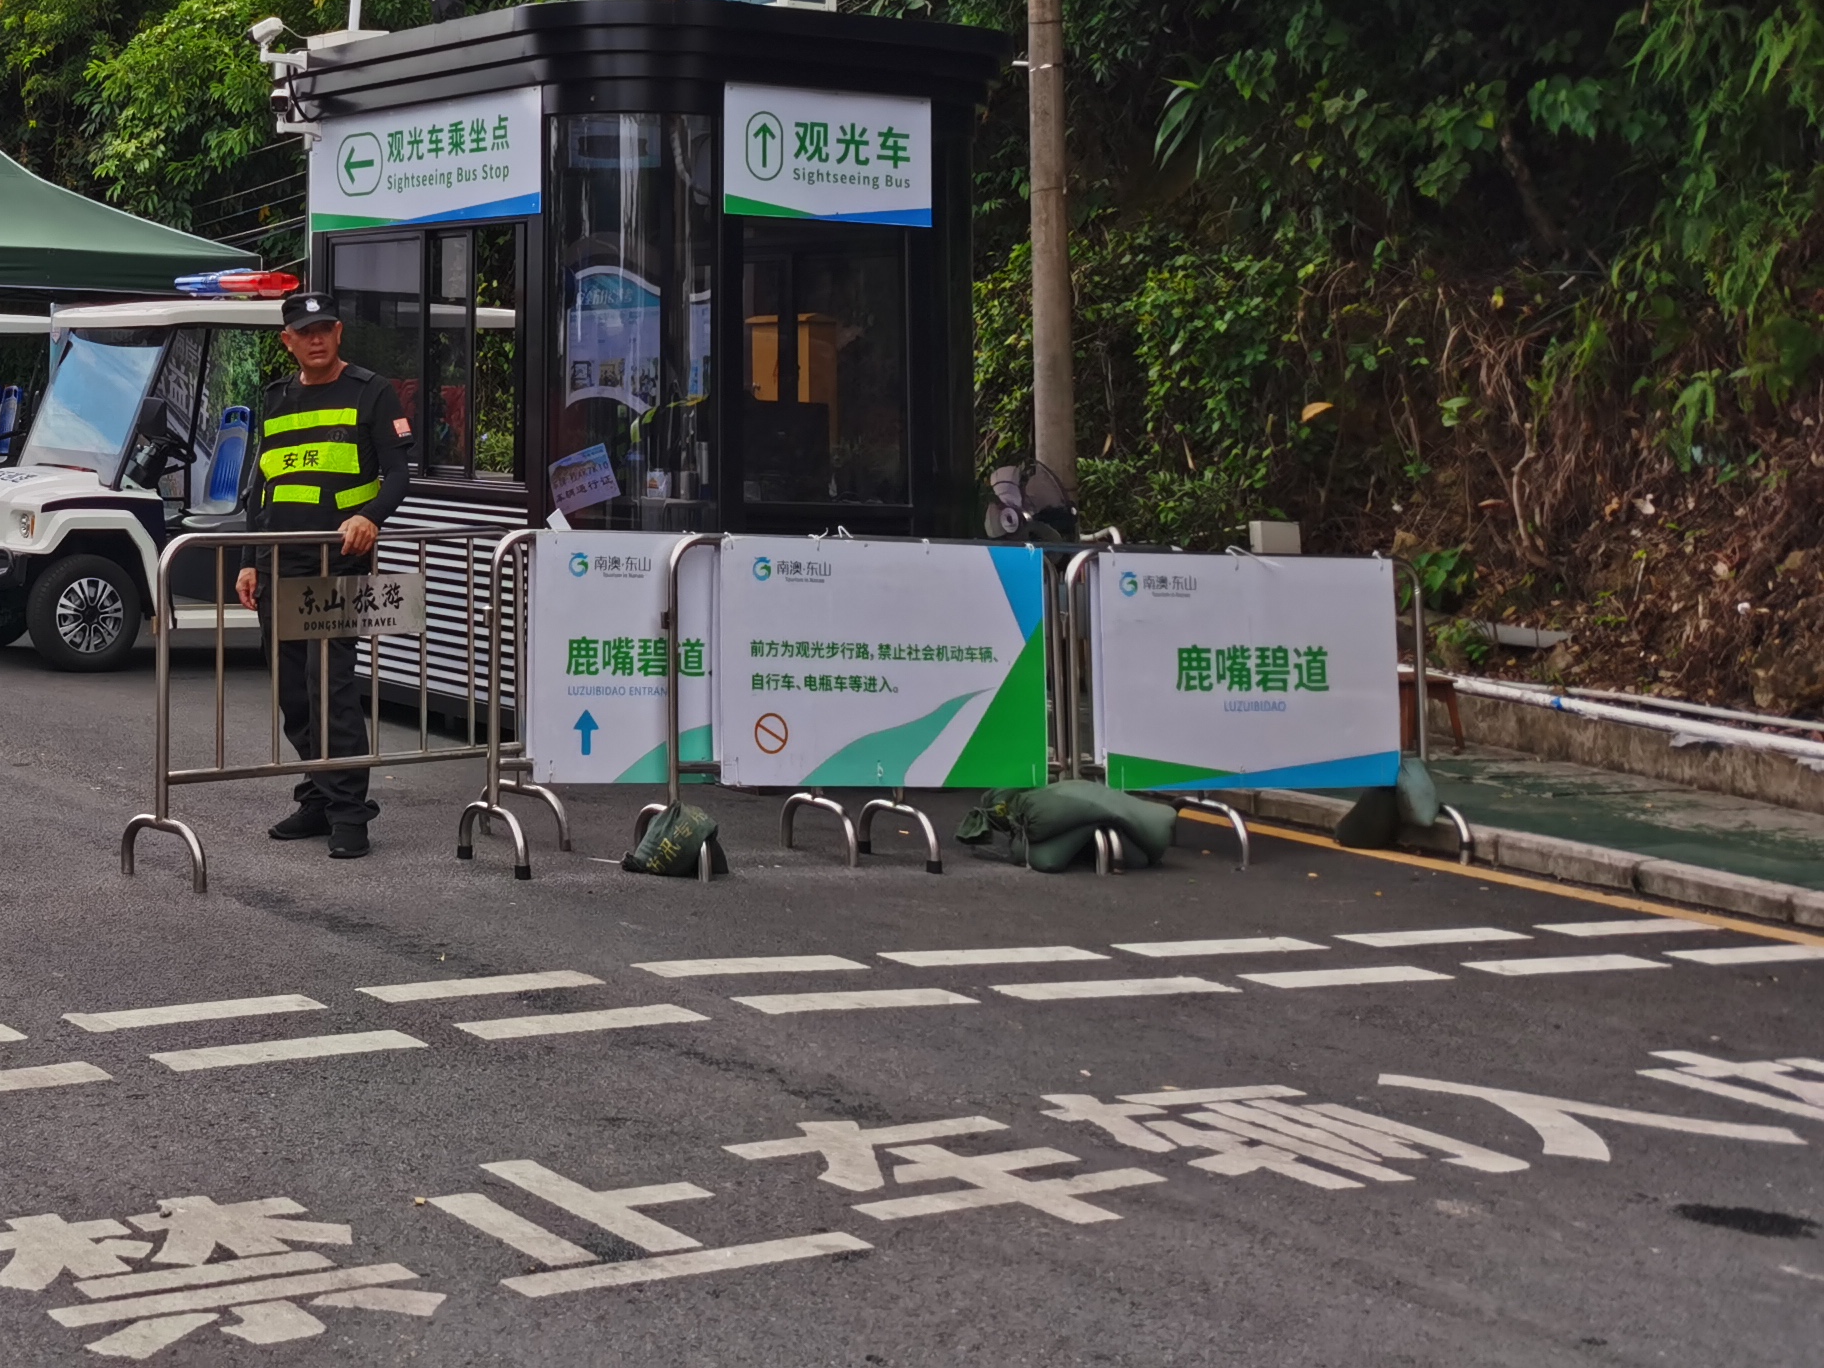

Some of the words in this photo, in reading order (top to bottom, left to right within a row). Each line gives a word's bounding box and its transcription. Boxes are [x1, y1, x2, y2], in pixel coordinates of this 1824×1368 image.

[387, 114, 509, 163] 观光车乘坐点
[793, 121, 911, 169] 观光车
[387, 169, 453, 193] Sightseeing
[457, 167, 477, 183] Bus
[482, 164, 509, 182] Stop
[793, 167, 880, 190] Sightseeing
[885, 175, 911, 189] Bus
[283, 450, 319, 470] 安保
[299, 582, 404, 616] 东山旅游
[304, 618, 358, 631] DONGSHAN
[362, 617, 397, 627] TRAVEL
[566, 636, 705, 677] 鹿嘴碧道
[1176, 644, 1330, 693] 鹿嘴碧道
[568, 686, 626, 696] LUZUIBIDAO
[751, 673, 898, 694] 自行车、电瓶车等进入。
[1224, 700, 1287, 712] LUZUIBIDAO
